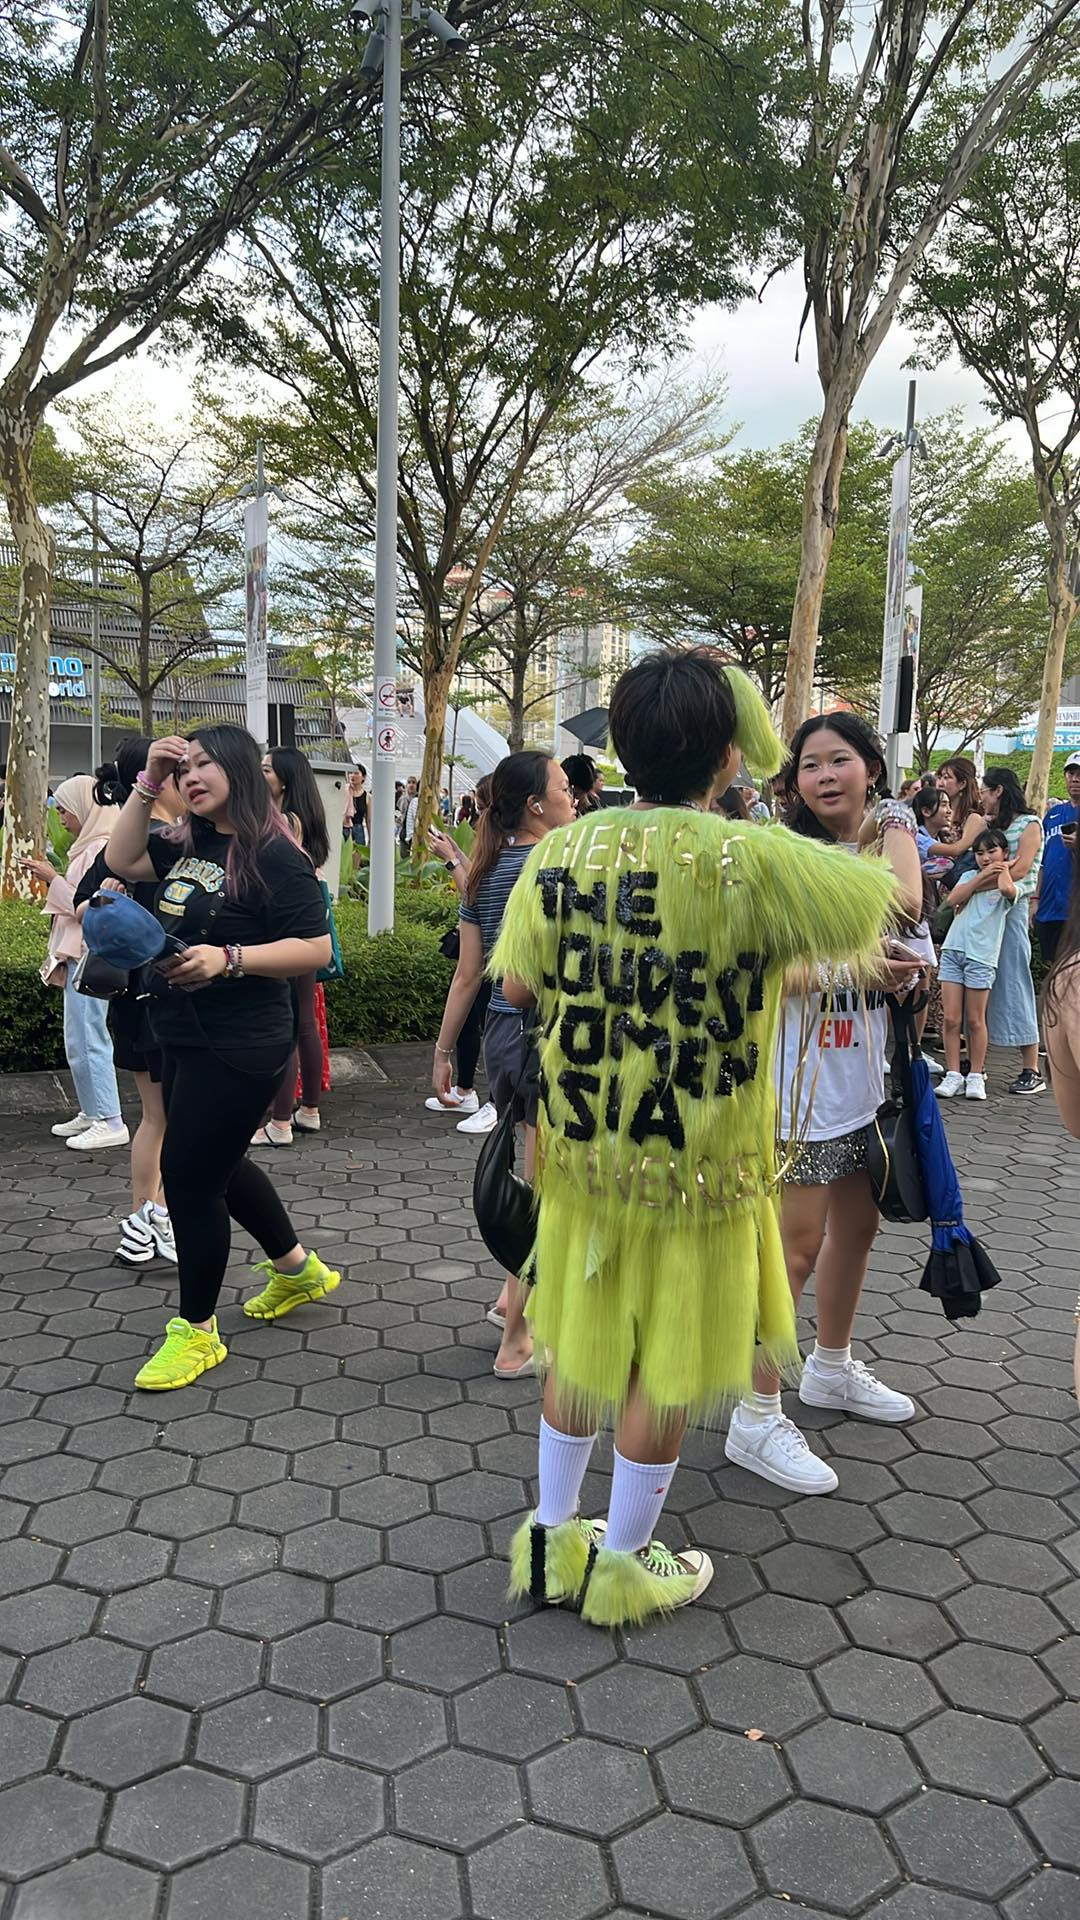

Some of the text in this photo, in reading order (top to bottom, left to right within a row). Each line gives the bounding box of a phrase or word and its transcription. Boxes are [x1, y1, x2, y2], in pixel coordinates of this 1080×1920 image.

[535, 866, 662, 940] THE
[543, 932, 770, 1043] OUDEST
[545, 1001, 760, 1098] OMEN
[540, 1065, 686, 1150] SIA
